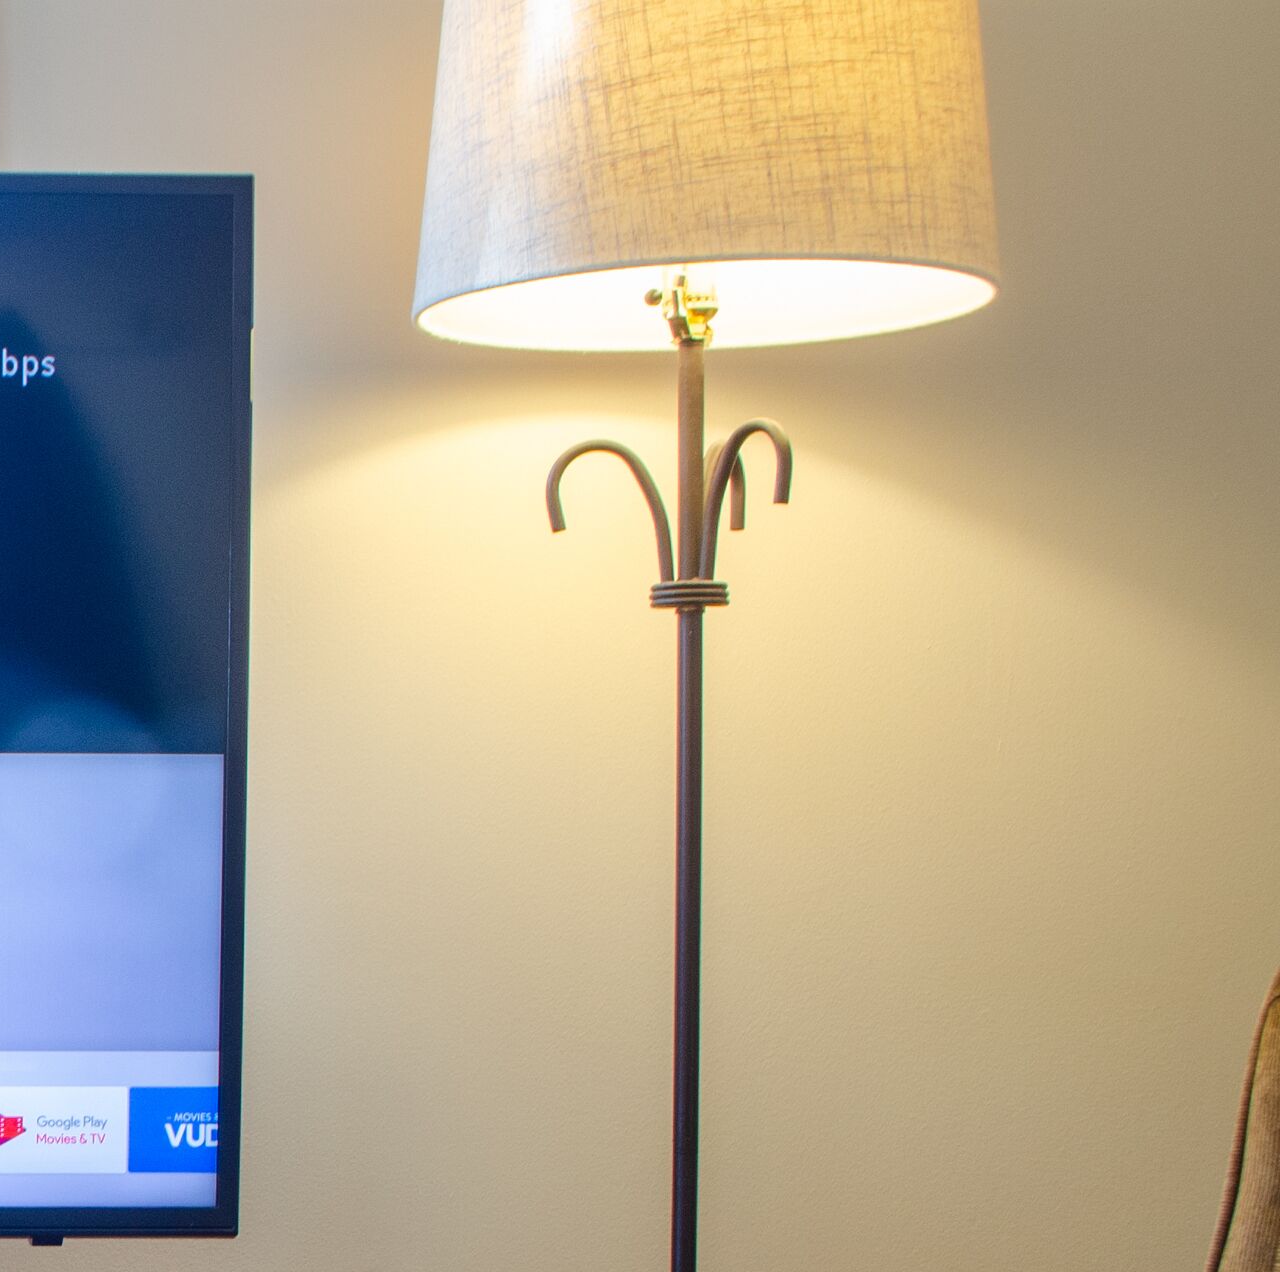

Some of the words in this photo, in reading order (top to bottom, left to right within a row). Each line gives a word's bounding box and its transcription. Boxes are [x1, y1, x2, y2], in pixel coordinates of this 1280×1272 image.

[36, 1115, 80, 1130] Google
[83, 1115, 108, 1130] Play
[174, 1112, 212, 1122] MOVIES
[36, 1133, 77, 1145] Movies
[79, 1133, 88, 1144] &
[90, 1133, 106, 1145] TV
